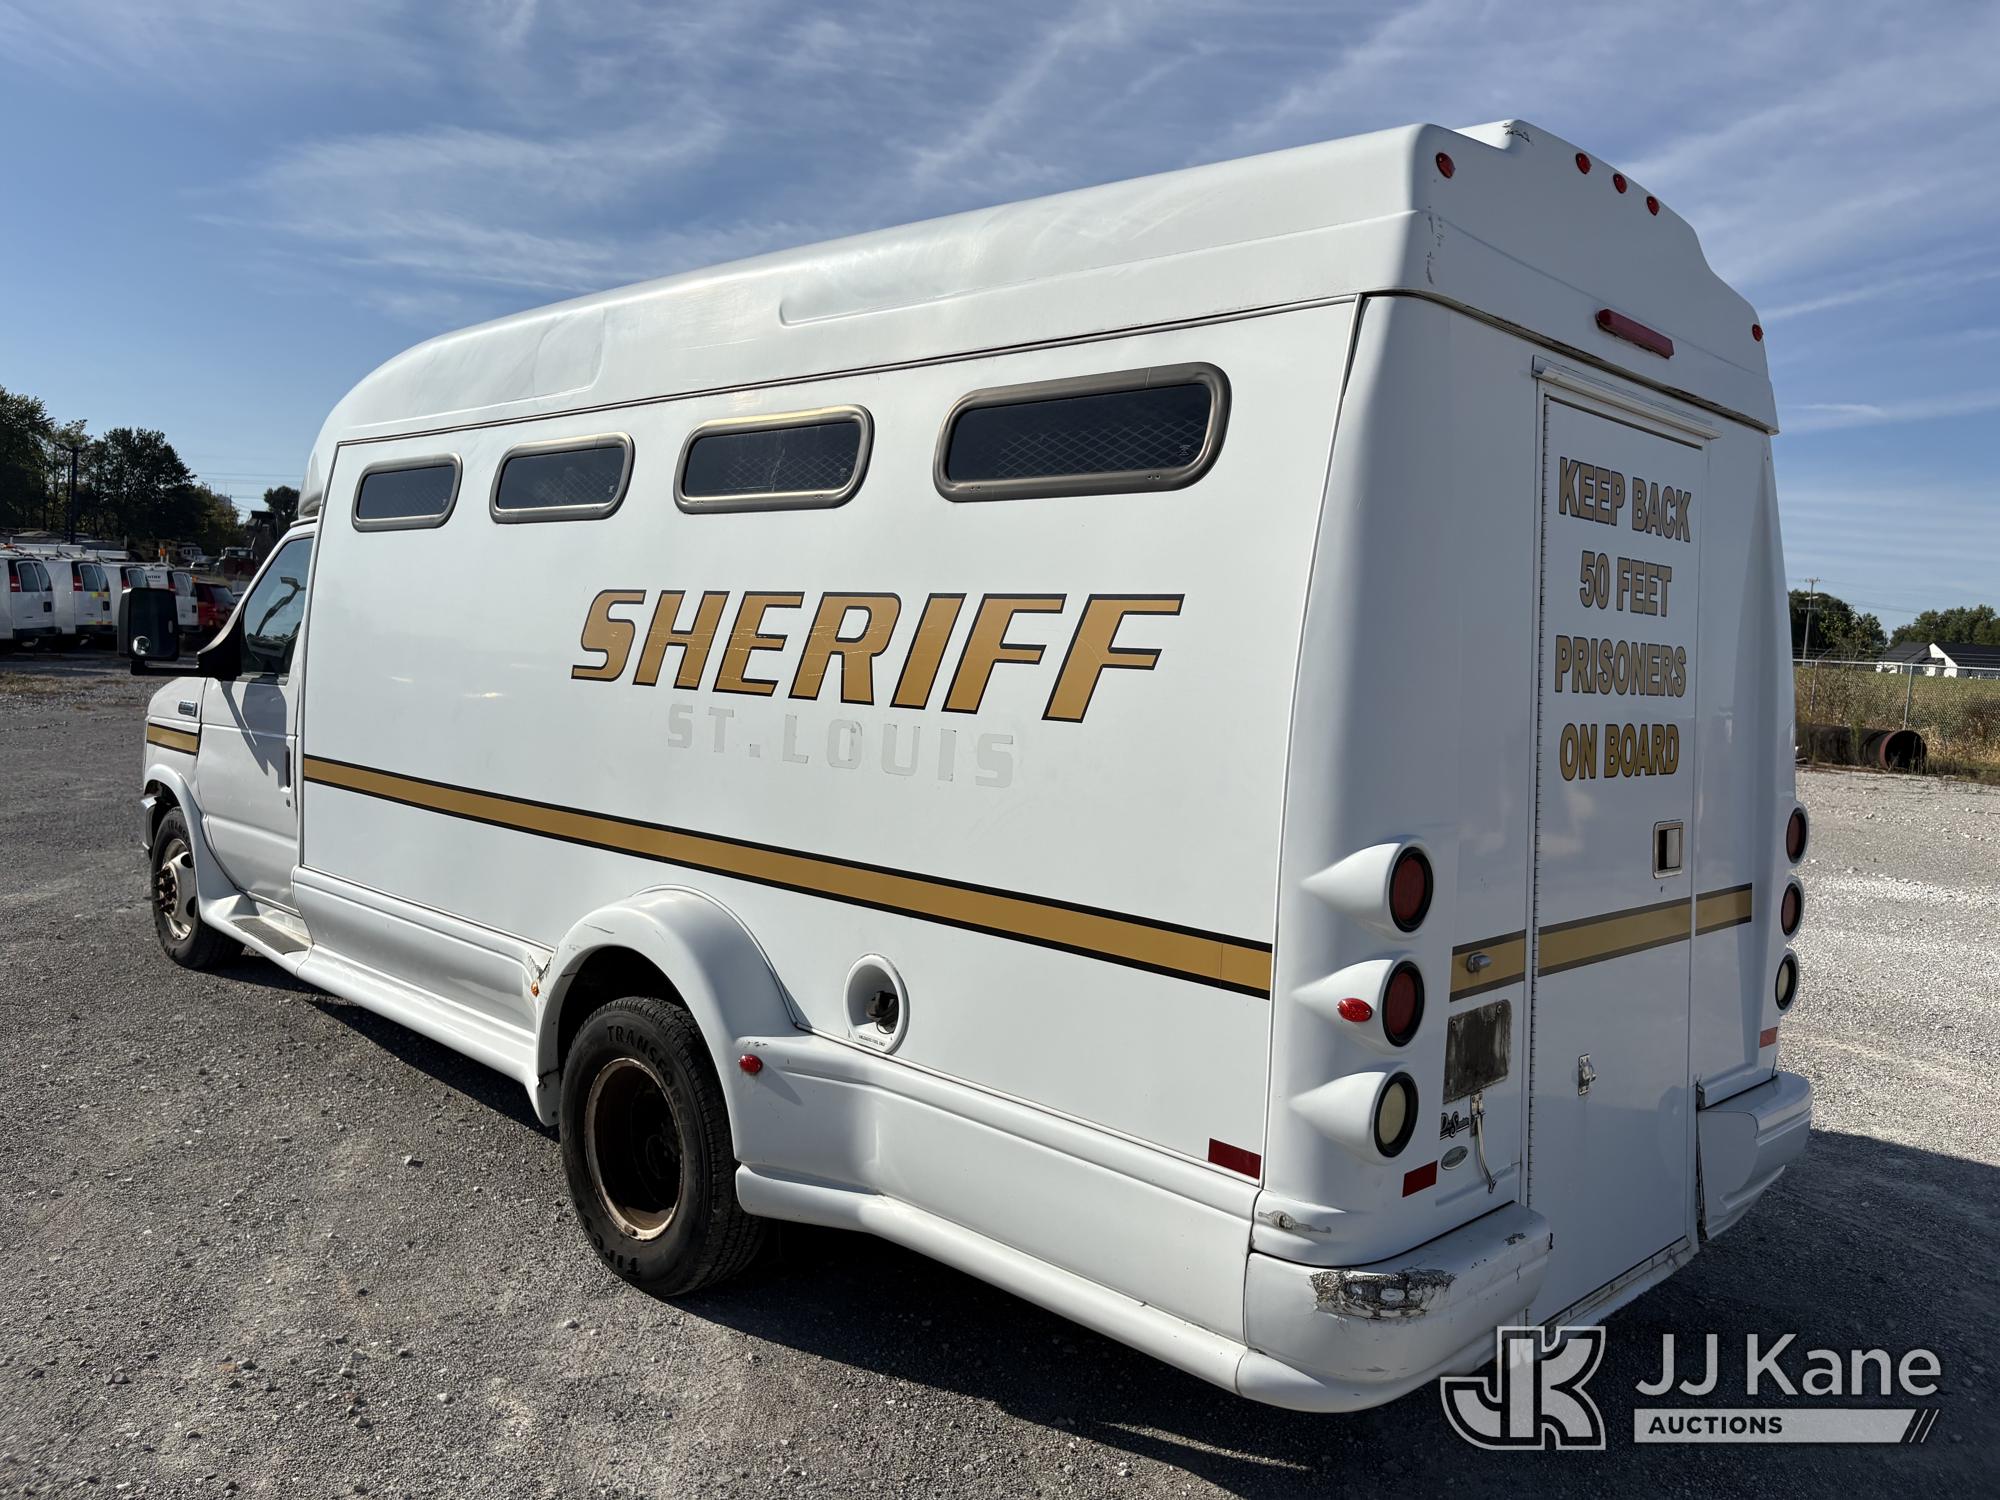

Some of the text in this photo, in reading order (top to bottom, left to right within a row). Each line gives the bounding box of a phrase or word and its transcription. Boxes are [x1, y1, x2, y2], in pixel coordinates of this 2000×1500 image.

[1559, 457, 1691, 542] KEEP BACK
[1580, 551, 1672, 617] 50 FEET
[571, 589, 1185, 723] SHERIFF
[1555, 635, 1686, 697] PRISONERS
[668, 703, 1014, 788] ST. LOUIS
[1560, 723, 1679, 781] ON BOARD
